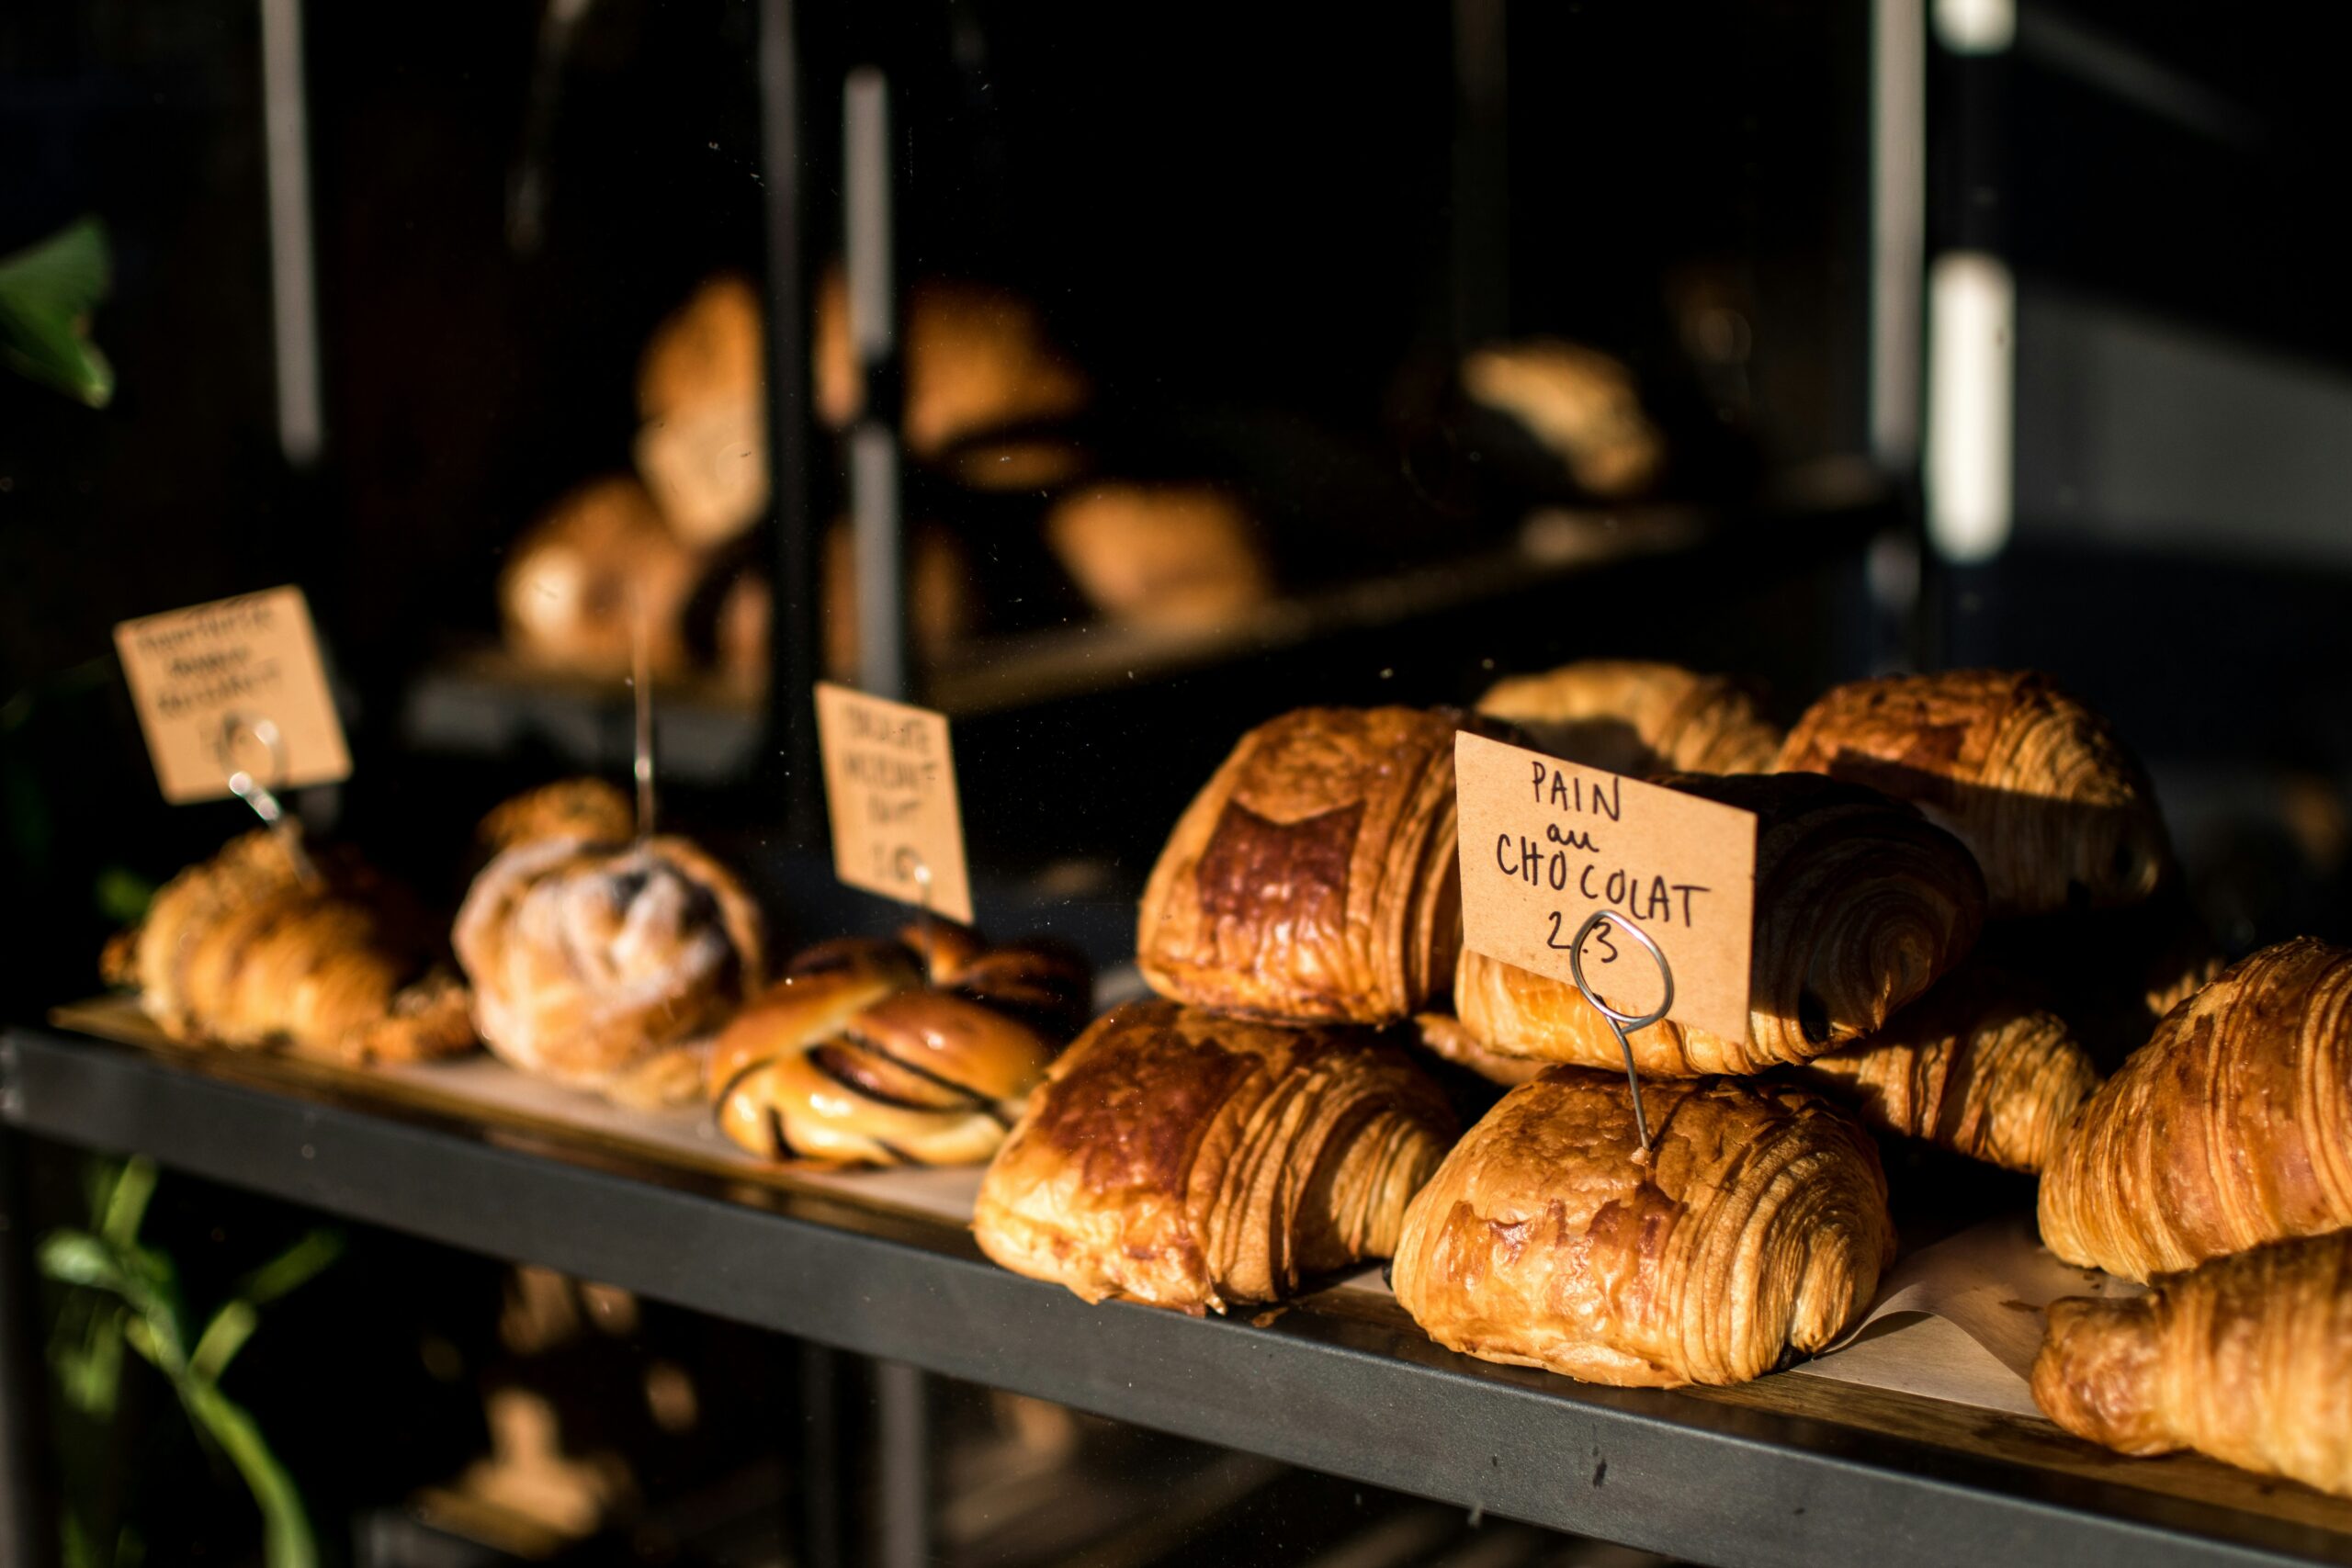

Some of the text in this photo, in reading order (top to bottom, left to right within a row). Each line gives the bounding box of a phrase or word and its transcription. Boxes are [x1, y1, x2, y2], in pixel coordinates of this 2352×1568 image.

[1532, 761, 1621, 822] PAIN
[1546, 823, 1600, 852] au
[1497, 833, 1711, 928] CHOCOLAT
[1547, 910, 1619, 964] 2.3
